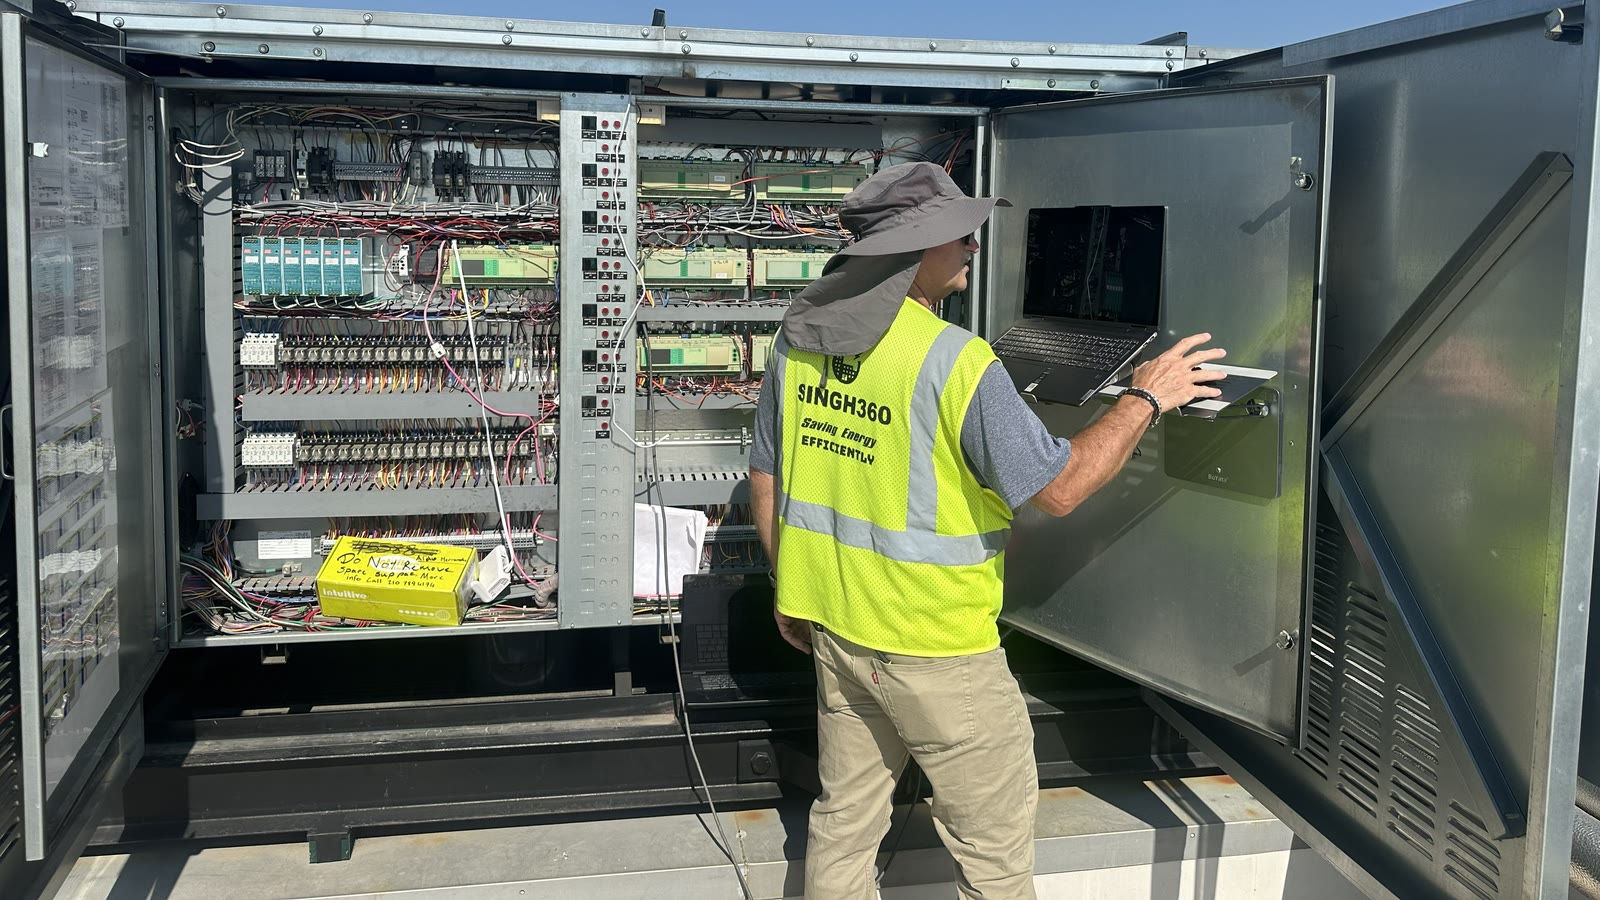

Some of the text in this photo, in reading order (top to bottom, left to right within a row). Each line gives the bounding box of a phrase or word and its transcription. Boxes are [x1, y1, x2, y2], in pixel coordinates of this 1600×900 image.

[797, 383, 892, 425] SINGH360
[801, 417, 877, 449] Saving Energy
[801, 435, 875, 465] EFFICIENTLY
[337, 553, 361, 564] Do
[367, 556, 397, 570] Not
[402, 560, 454, 573] Remove
[337, 566, 366, 575] Spare
[346, 574, 361, 582] info
